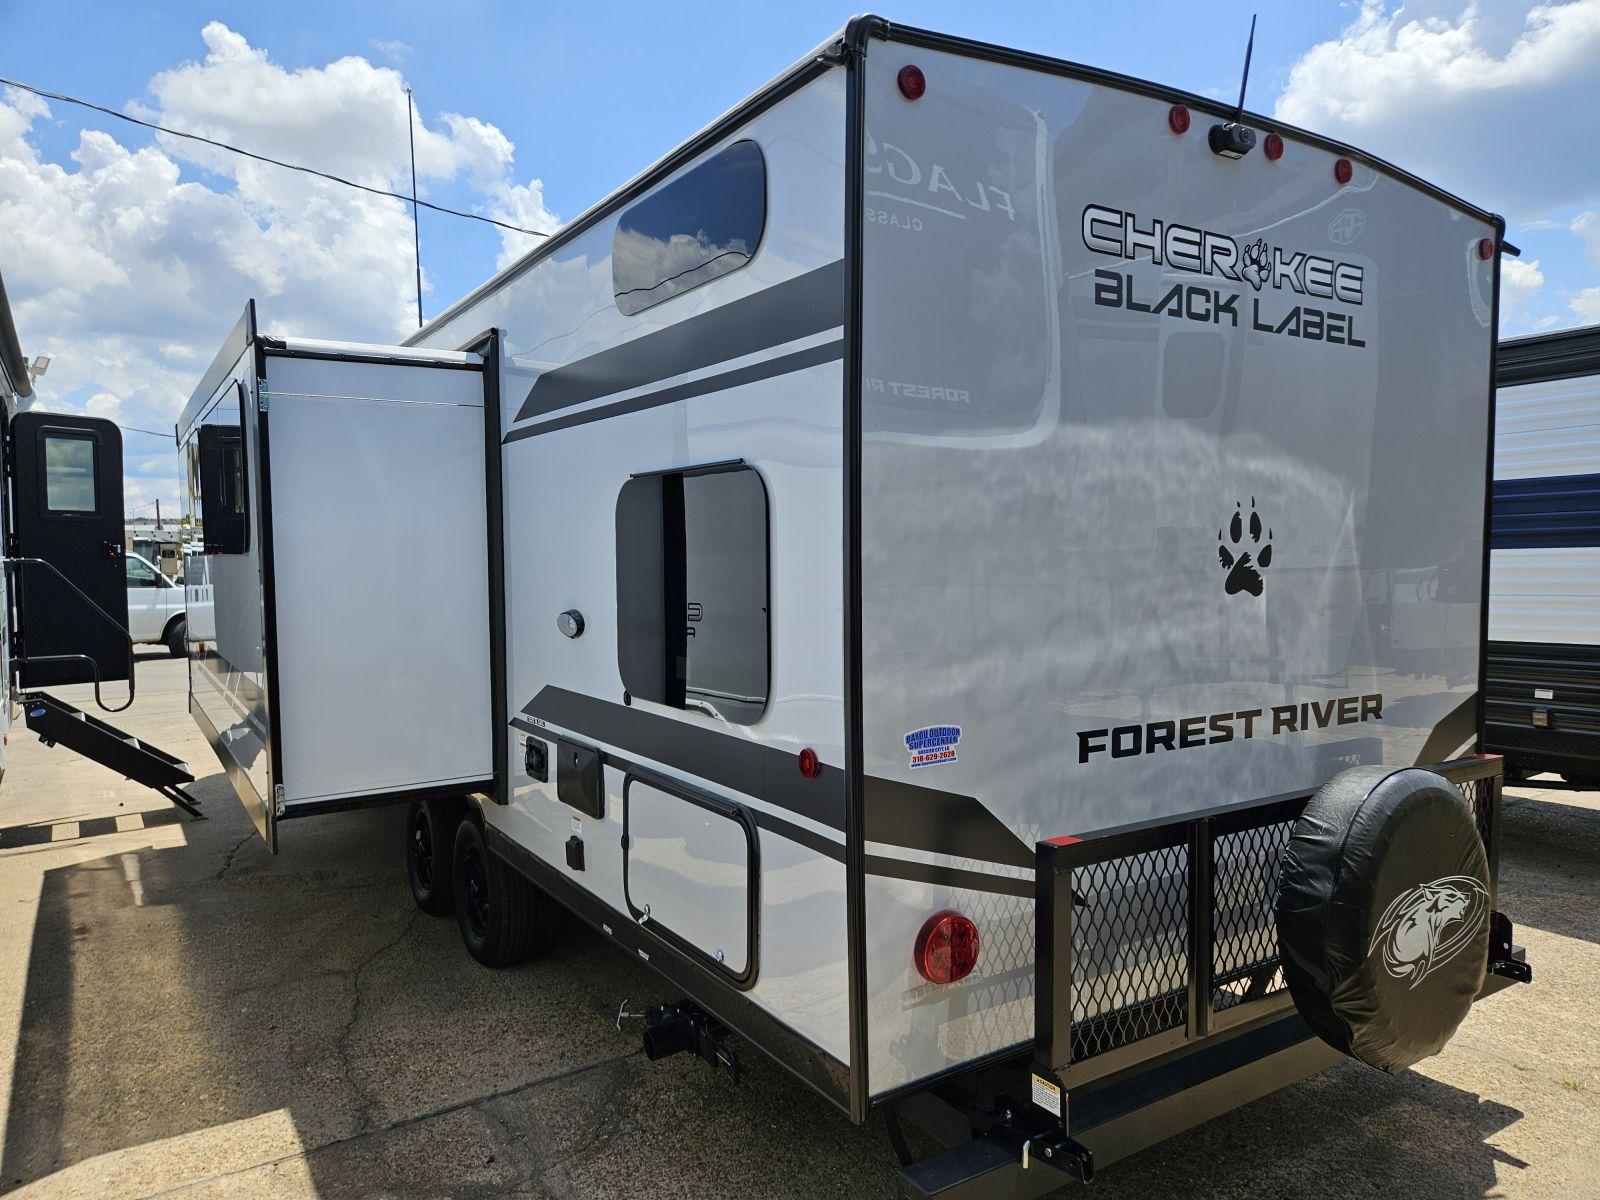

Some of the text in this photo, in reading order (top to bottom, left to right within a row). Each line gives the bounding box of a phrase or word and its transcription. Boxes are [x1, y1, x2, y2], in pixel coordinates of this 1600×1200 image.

[1081, 203, 1364, 306] CHERKEE
[1094, 268, 1366, 348] BLACK LABEL
[909, 736, 958, 750] SUPERCENTER
[929, 727, 960, 737] OUTDOOR
[1075, 693, 1383, 764] FOREST RIVER
